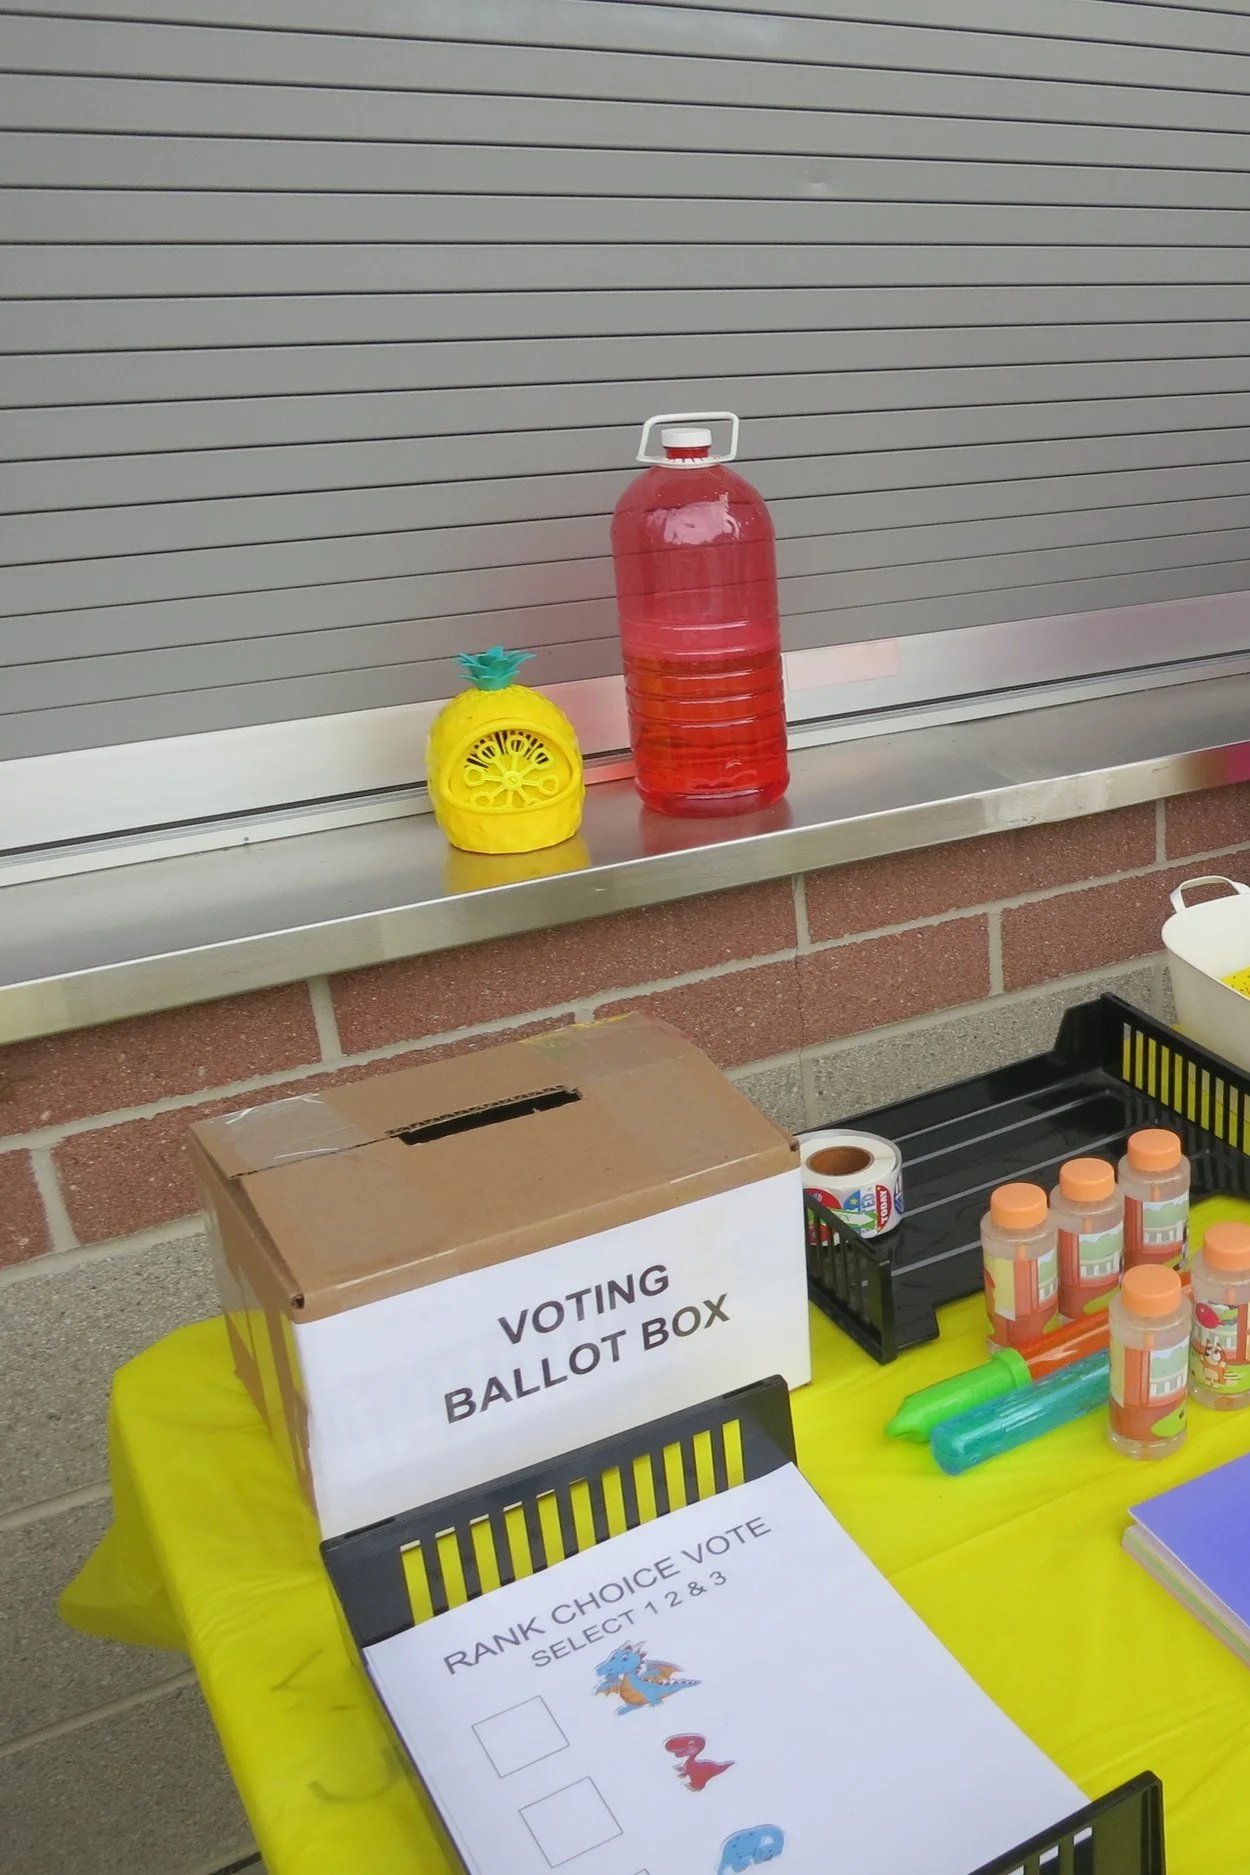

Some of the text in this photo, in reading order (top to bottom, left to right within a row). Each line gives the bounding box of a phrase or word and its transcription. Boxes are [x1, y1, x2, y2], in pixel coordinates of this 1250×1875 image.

[880, 1190, 888, 1224] TODAY
[497, 1264, 670, 1345] VOTING
[444, 1292, 731, 1424] BALLOT BOX
[443, 1516, 772, 1675] RANK CHOICE VOTE
[531, 1570, 727, 1668] SELECT 1 2 & 3
